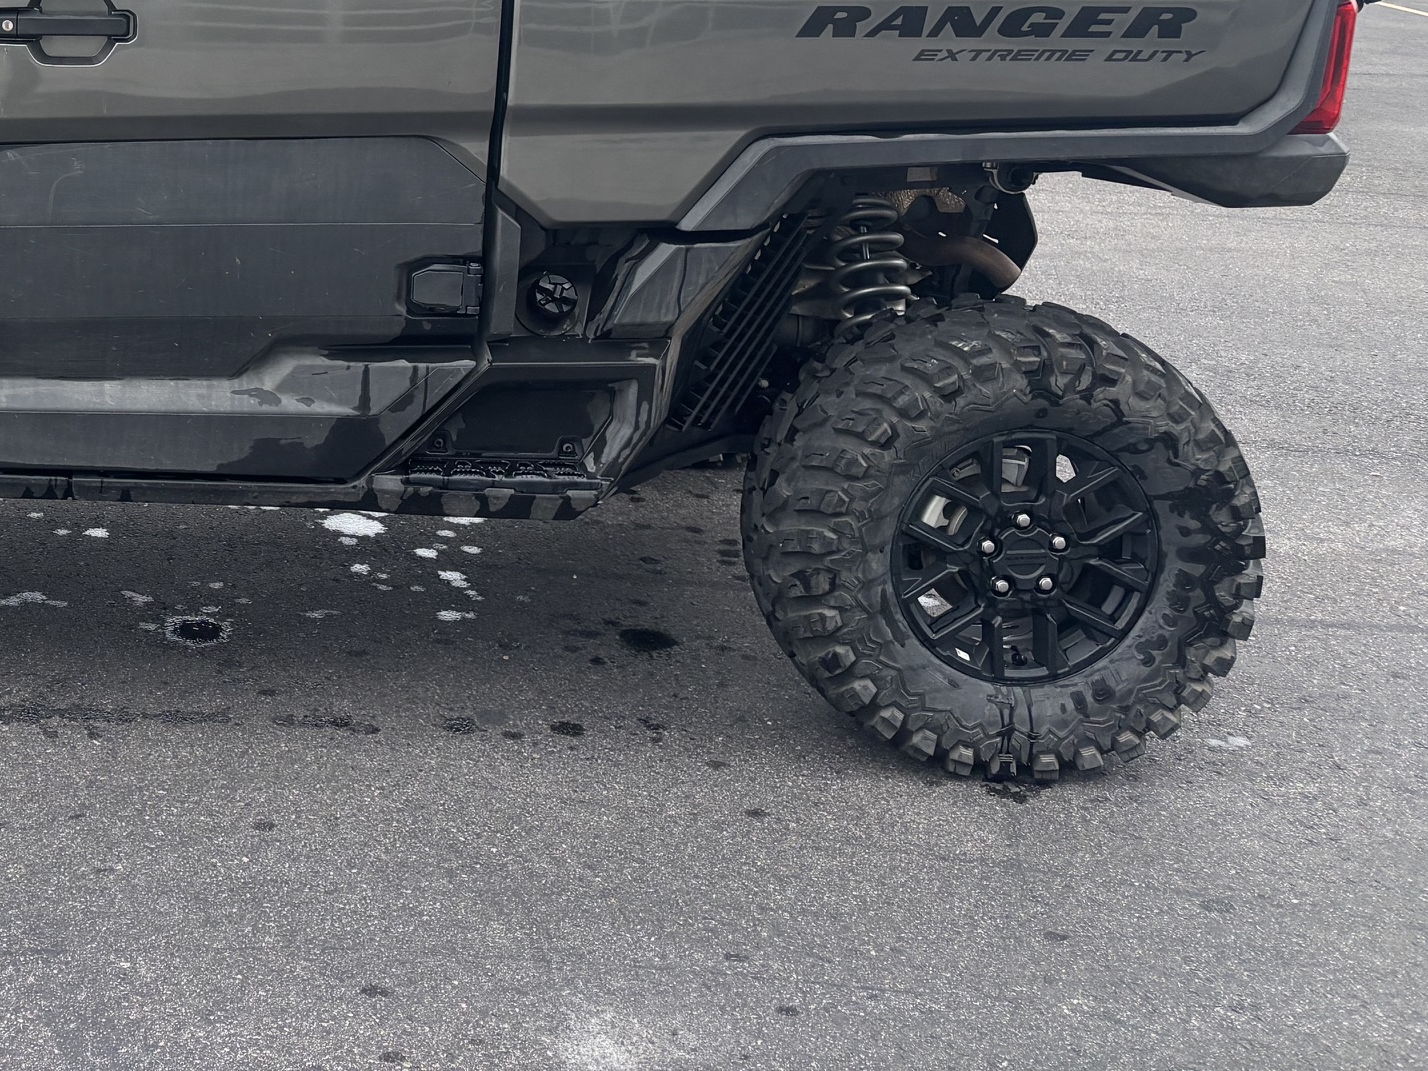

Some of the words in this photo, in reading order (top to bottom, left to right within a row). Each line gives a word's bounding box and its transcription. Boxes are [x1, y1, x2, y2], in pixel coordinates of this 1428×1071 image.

[795, 5, 1198, 38] RANGER
[912, 49, 1095, 62] EXTREME
[1103, 50, 1207, 63] DUTY
